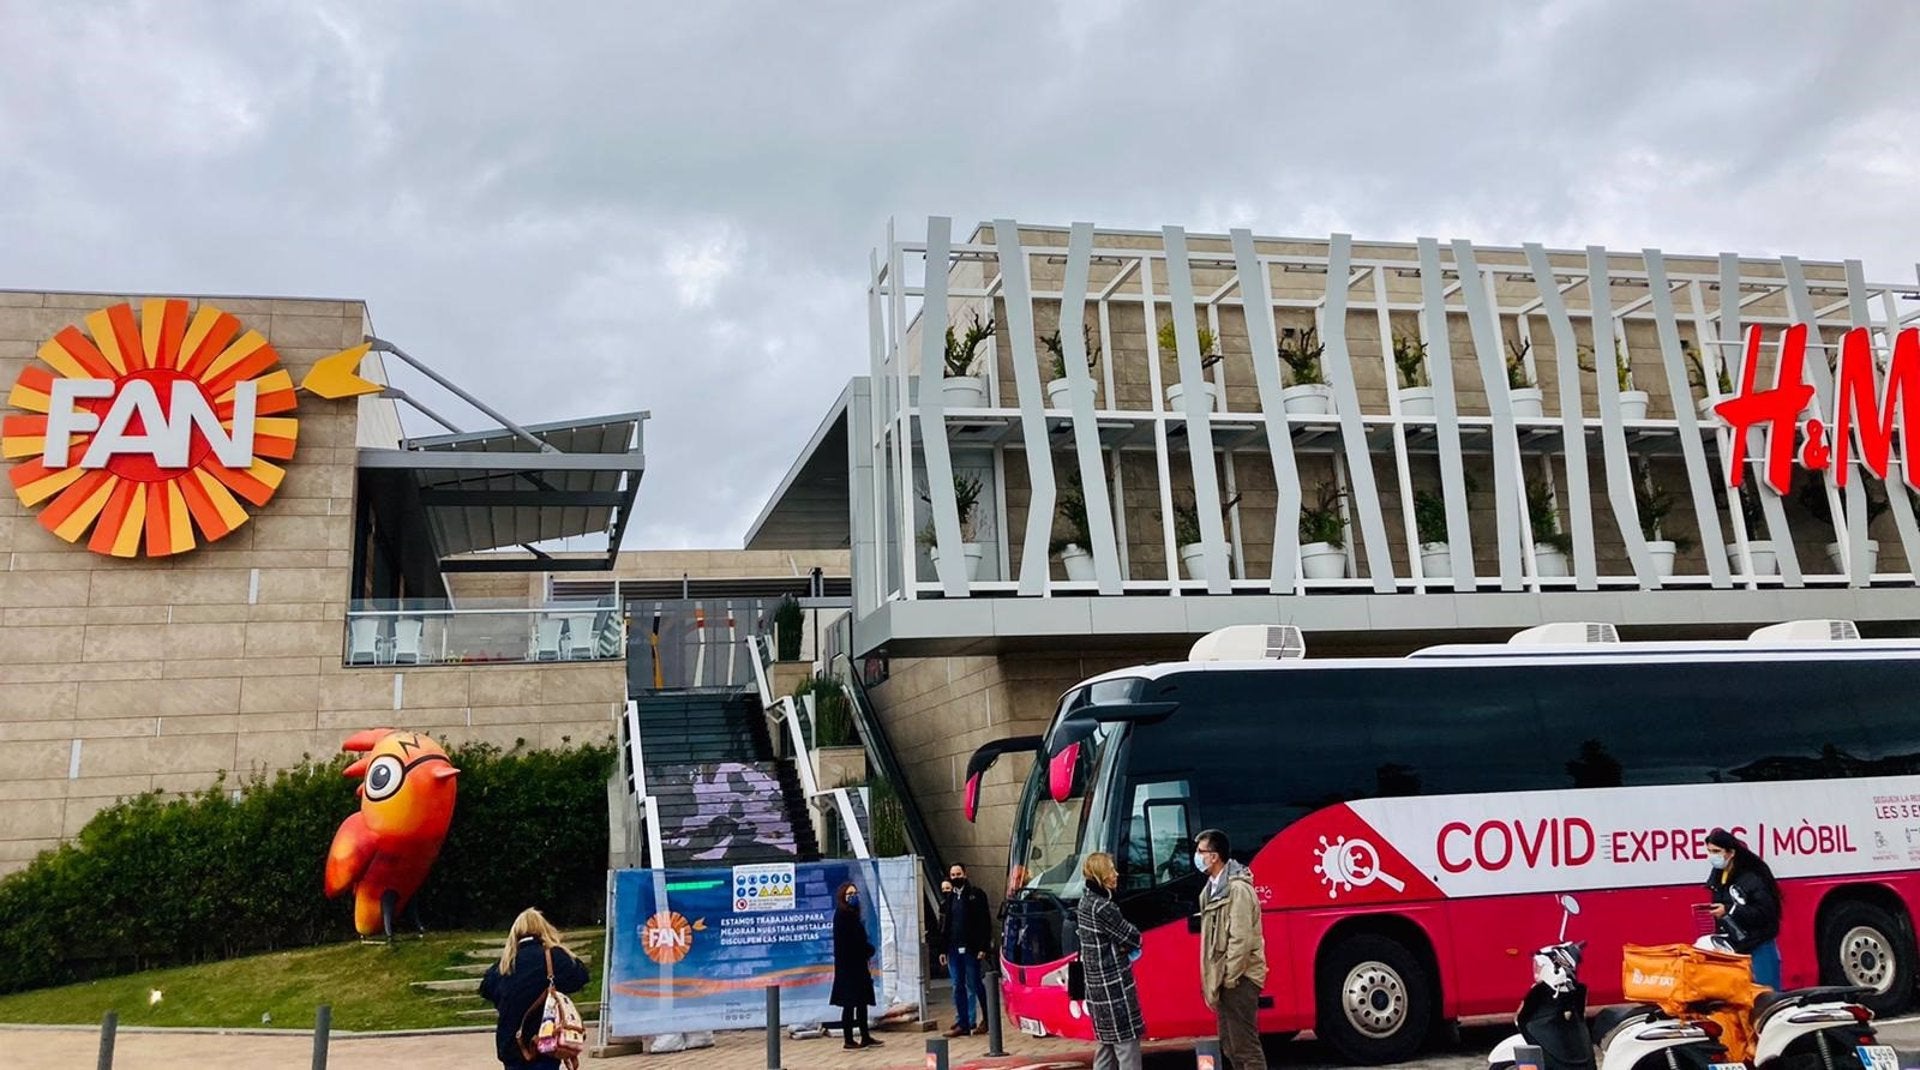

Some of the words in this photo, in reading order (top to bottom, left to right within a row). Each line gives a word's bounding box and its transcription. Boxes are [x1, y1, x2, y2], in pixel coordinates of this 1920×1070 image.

[1713, 323, 1920, 496] H&M
[42, 378, 258, 469] FAN
[1875, 805, 1899, 819] LES
[1900, 804, 1909, 818] 3
[1436, 817, 1596, 873] COVID
[1773, 818, 1857, 856] MÒBIL
[721, 917, 755, 926] ESTAMOS
[756, 914, 804, 925] TRABAJANDO
[805, 912, 825, 921] PARA
[649, 927, 685, 948] FAN
[720, 926, 756, 936] MEJORAR
[756, 924, 796, 934] NUESTRAS
[720, 936, 762, 946] DISCULPEN
[762, 934, 777, 943] LAS
[778, 933, 820, 943] MOLESTIAS
